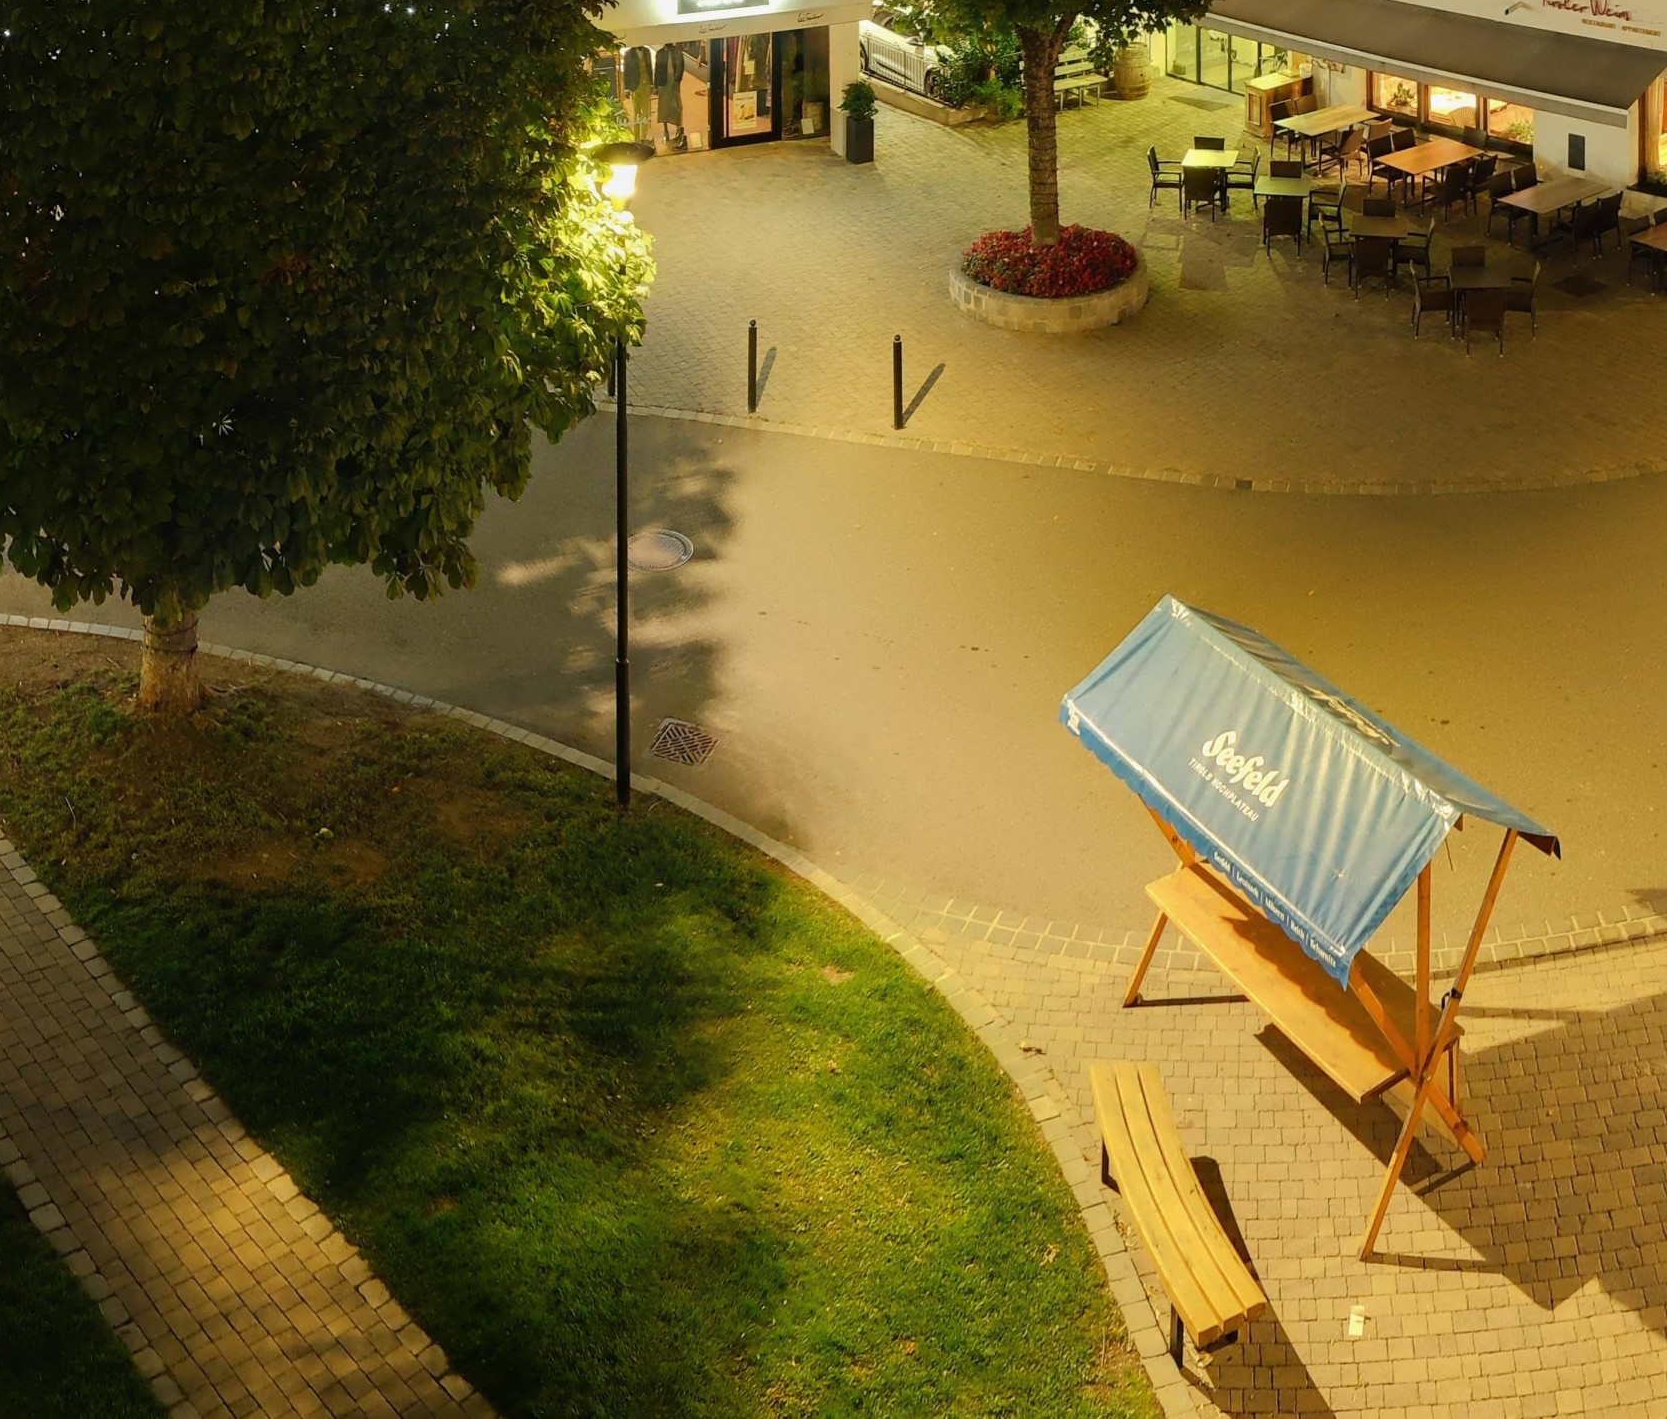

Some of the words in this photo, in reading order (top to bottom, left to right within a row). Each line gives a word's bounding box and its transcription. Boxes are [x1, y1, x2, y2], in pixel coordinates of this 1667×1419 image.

[1187, 757, 1215, 786] TIROLS
[1211, 775, 1259, 823] HOCHPLATEAU
[1201, 729, 1290, 809] Seefeld
